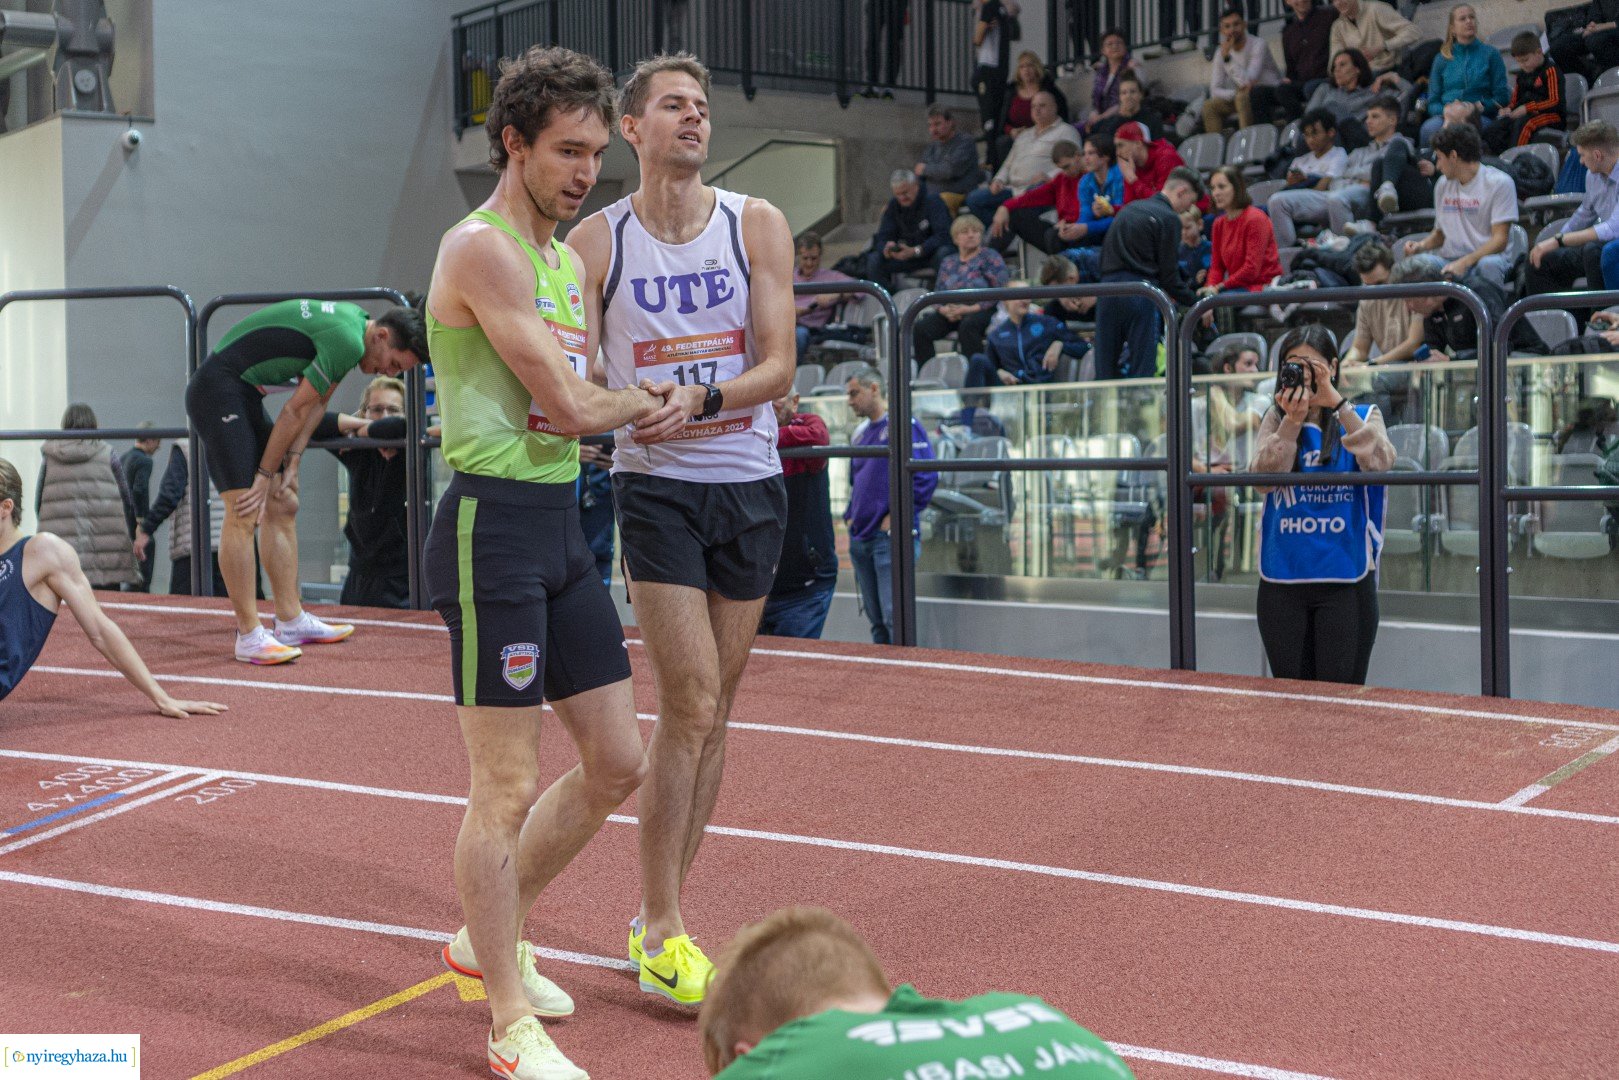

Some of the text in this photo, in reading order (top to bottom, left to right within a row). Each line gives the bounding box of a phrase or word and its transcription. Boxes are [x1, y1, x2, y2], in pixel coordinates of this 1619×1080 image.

[630, 269, 735, 314] UTE
[675, 336, 734, 350] FEDETTPÁLYÁS
[673, 361, 717, 386] 117
[725, 422, 744, 432] 2023
[1280, 516, 1346, 534] PHOTO
[39, 765, 113, 789] 400
[175, 779, 257, 805] 200
